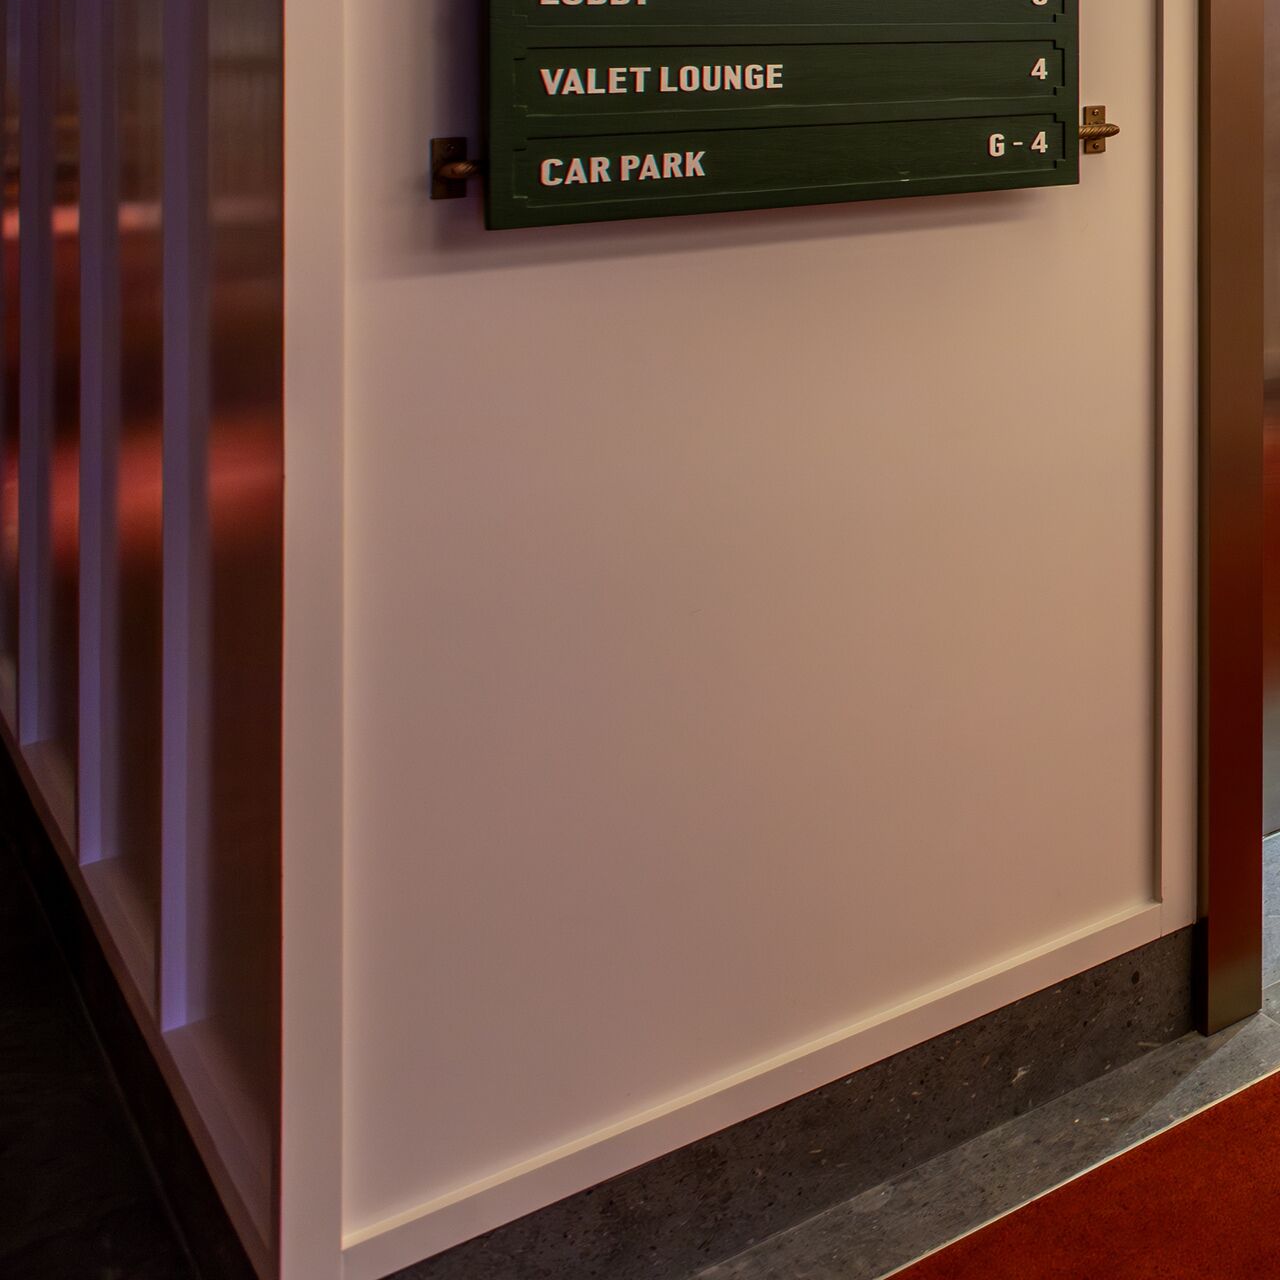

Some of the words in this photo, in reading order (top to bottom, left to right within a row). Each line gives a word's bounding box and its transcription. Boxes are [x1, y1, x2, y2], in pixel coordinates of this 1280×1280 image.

[540, 66, 652, 95] VALET
[660, 63, 784, 92] LOUNGE
[1031, 57, 1049, 80] 4
[541, 156, 612, 186] CAR
[621, 150, 706, 181] PARK
[988, 133, 1005, 157] G
[1031, 131, 1049, 153] 4
